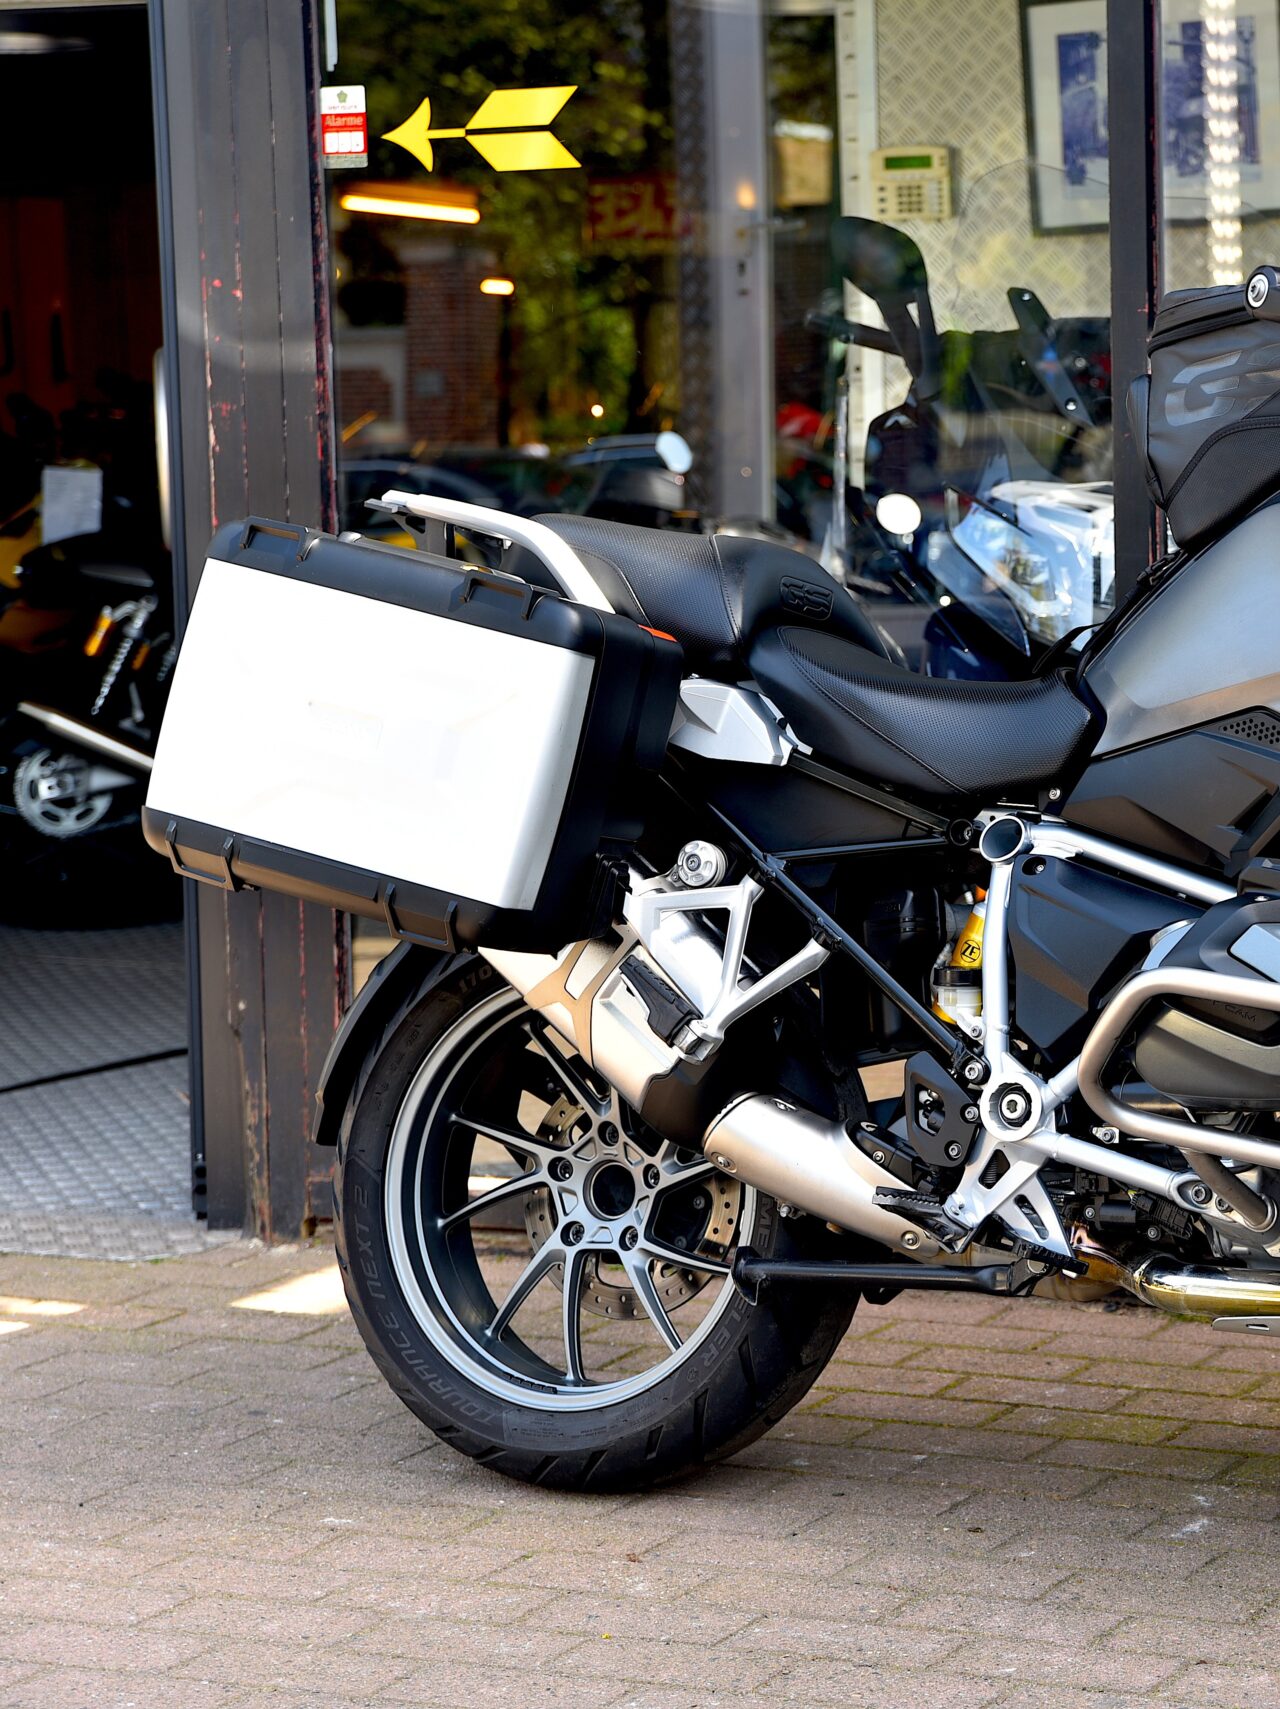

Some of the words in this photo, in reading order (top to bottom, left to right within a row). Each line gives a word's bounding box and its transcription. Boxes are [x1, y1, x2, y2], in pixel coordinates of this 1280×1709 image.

[325, 115, 363, 127] Alarme
[781, 577, 832, 616] GS
[960, 940, 981, 962] ZF
[354, 1185, 370, 1206] 2
[378, 1311, 494, 1427] TOURANCE
